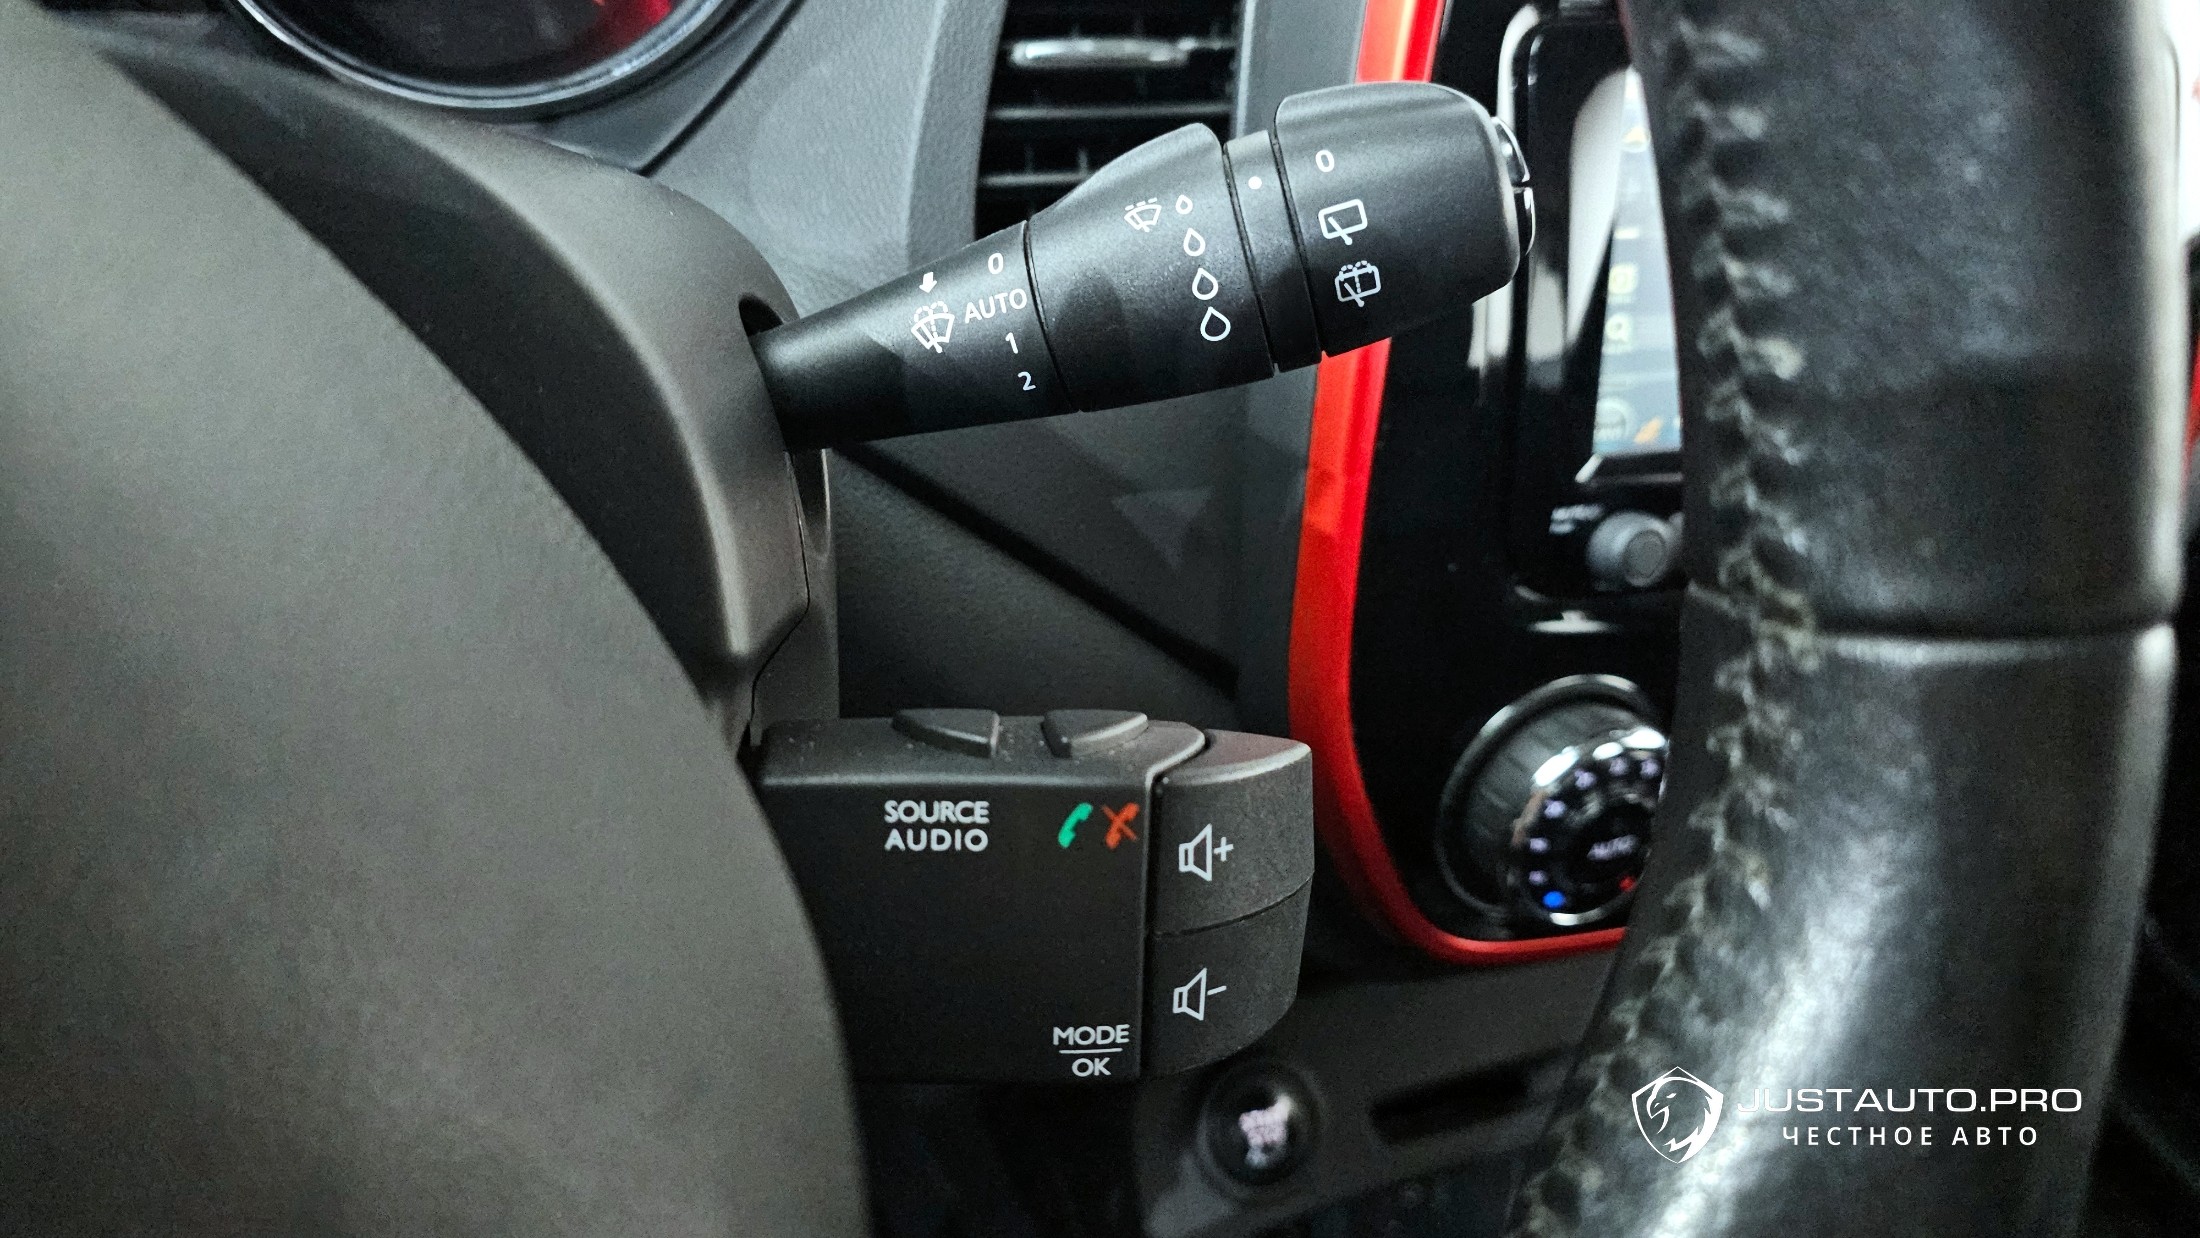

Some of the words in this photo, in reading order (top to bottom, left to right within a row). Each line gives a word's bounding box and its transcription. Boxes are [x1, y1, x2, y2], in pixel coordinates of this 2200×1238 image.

[1316, 149, 1335, 173] 0
[987, 253, 1004, 275] 0
[964, 288, 1028, 324] AUTO
[1004, 332, 1019, 354] 1
[1017, 371, 1036, 391] 2
[884, 800, 989, 824] SOURCE
[884, 828, 989, 852] AUDIO
[1053, 1024, 1130, 1046] MODE
[1072, 1058, 1112, 1078] OK
